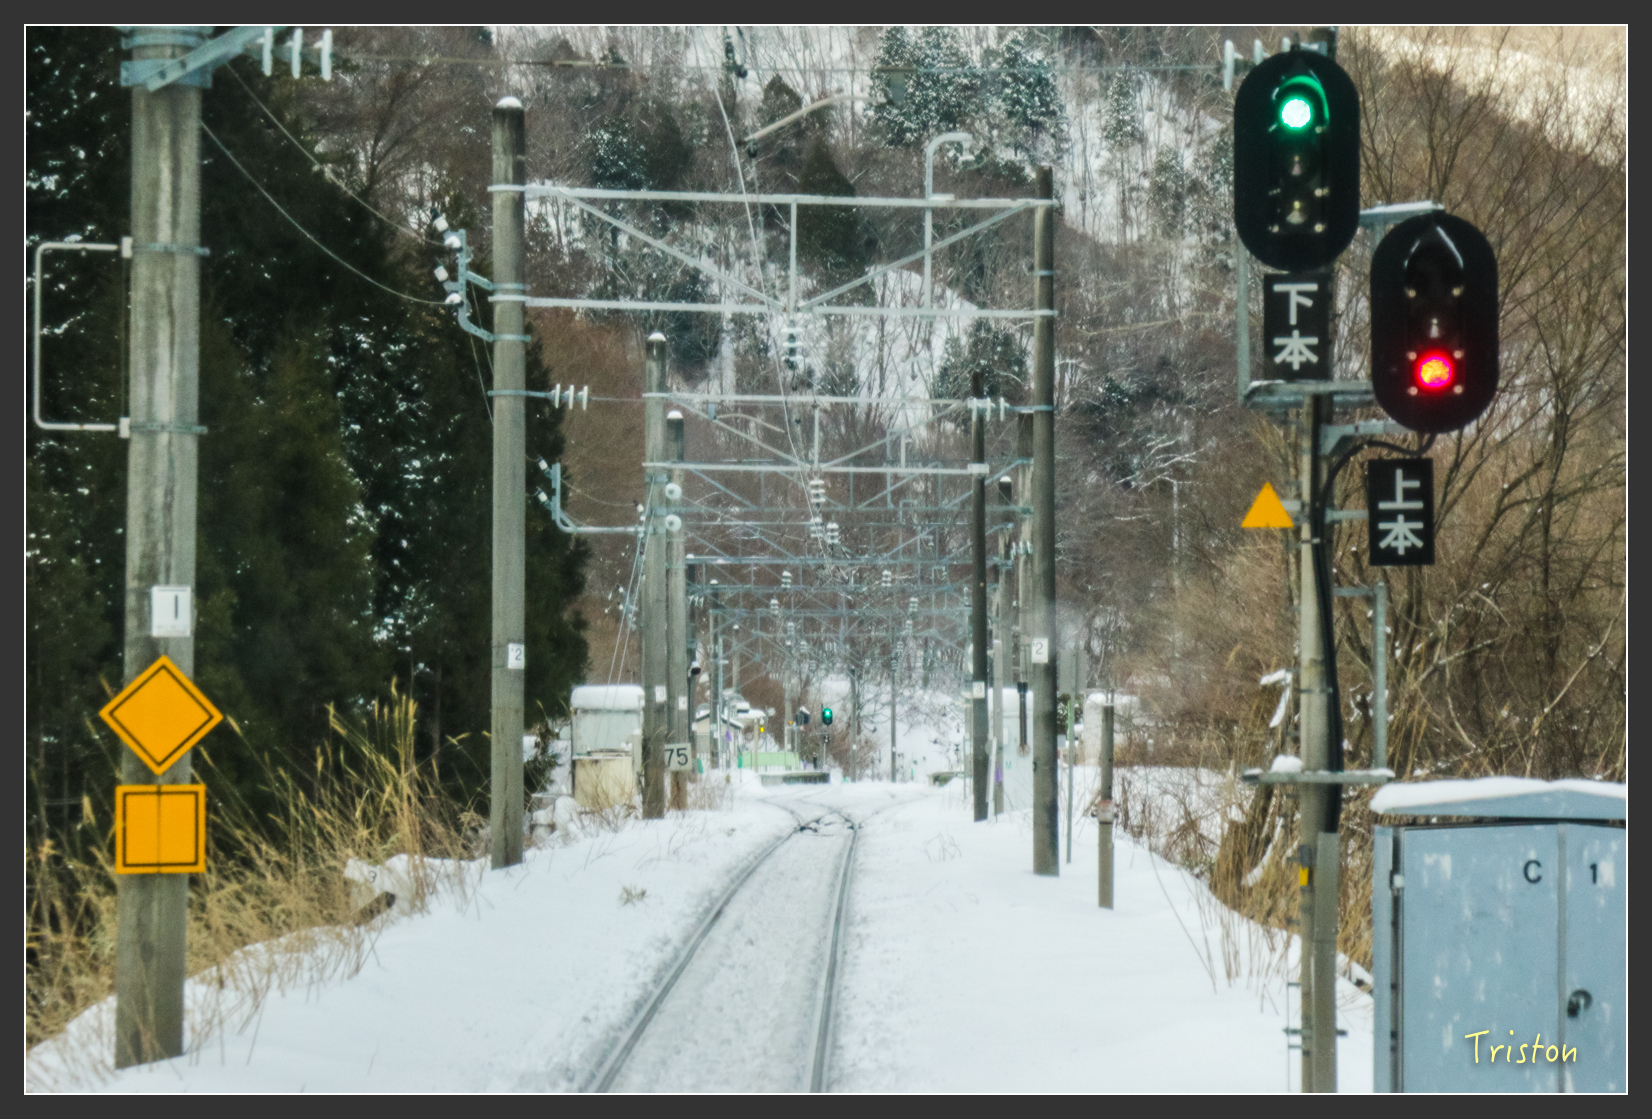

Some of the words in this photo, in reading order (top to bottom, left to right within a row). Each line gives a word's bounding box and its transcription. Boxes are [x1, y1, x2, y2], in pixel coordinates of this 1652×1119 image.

[1273, 283, 1318, 370] 下本
[1378, 468, 1424, 555] 上本
[664, 747, 688, 767] 75
[1523, 859, 1542, 885] C
[1589, 862, 1597, 885] 1
